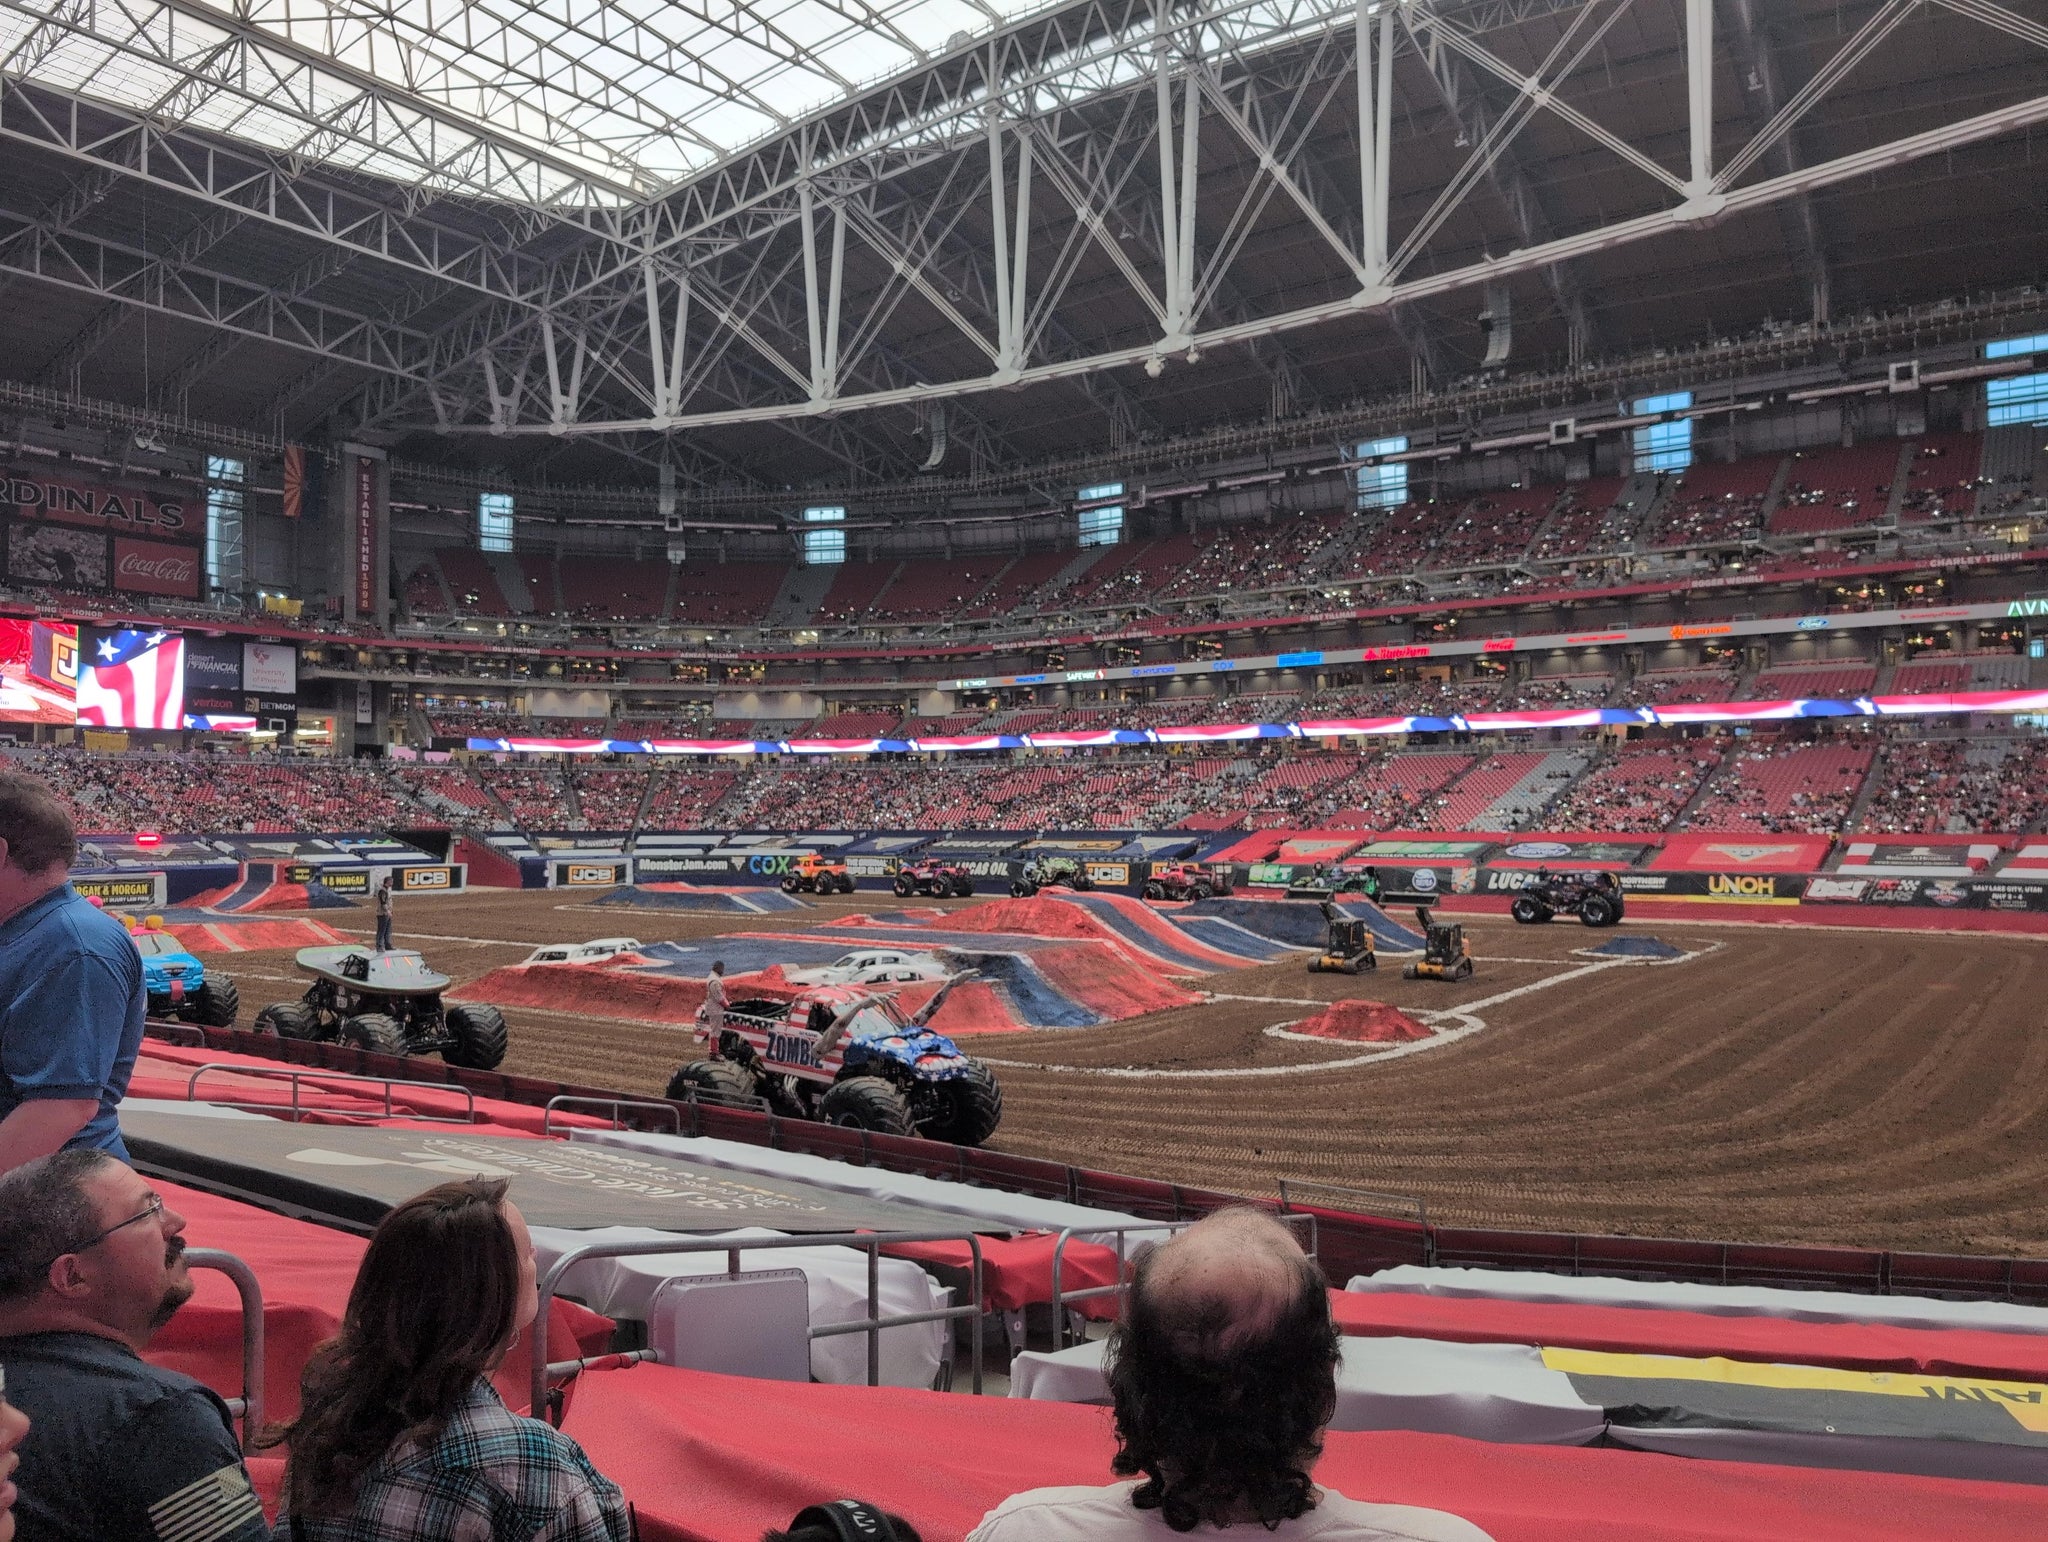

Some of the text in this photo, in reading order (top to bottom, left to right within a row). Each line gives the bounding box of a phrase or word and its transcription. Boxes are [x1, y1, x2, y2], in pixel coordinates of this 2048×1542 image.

[361, 474, 370, 572] ESTABLISHED
[119, 553, 195, 583] Coca-Cola
[35, 605, 57, 613] RING
[72, 608, 103, 618] HONOR
[1066, 671, 1096, 682] SAFEWAY
[192, 699, 233, 709] verizon
[261, 702, 296, 711] BETMGM
[639, 858, 728, 871] MonsterJam.com
[749, 855, 791, 875] COX
[989, 862, 1009, 876] OIL
[335, 876, 365, 885] MORGAN
[407, 871, 447, 885] JCB
[572, 869, 611, 881] JCB
[1088, 867, 1126, 881] JCB
[1487, 872, 1541, 890] LUCA
[1708, 872, 1775, 894] UNOH
[102, 885, 109, 895] &
[111, 884, 148, 895] MORGAN
[1872, 890, 1914, 901] CARS
[765, 1030, 824, 1069] ZOMB
